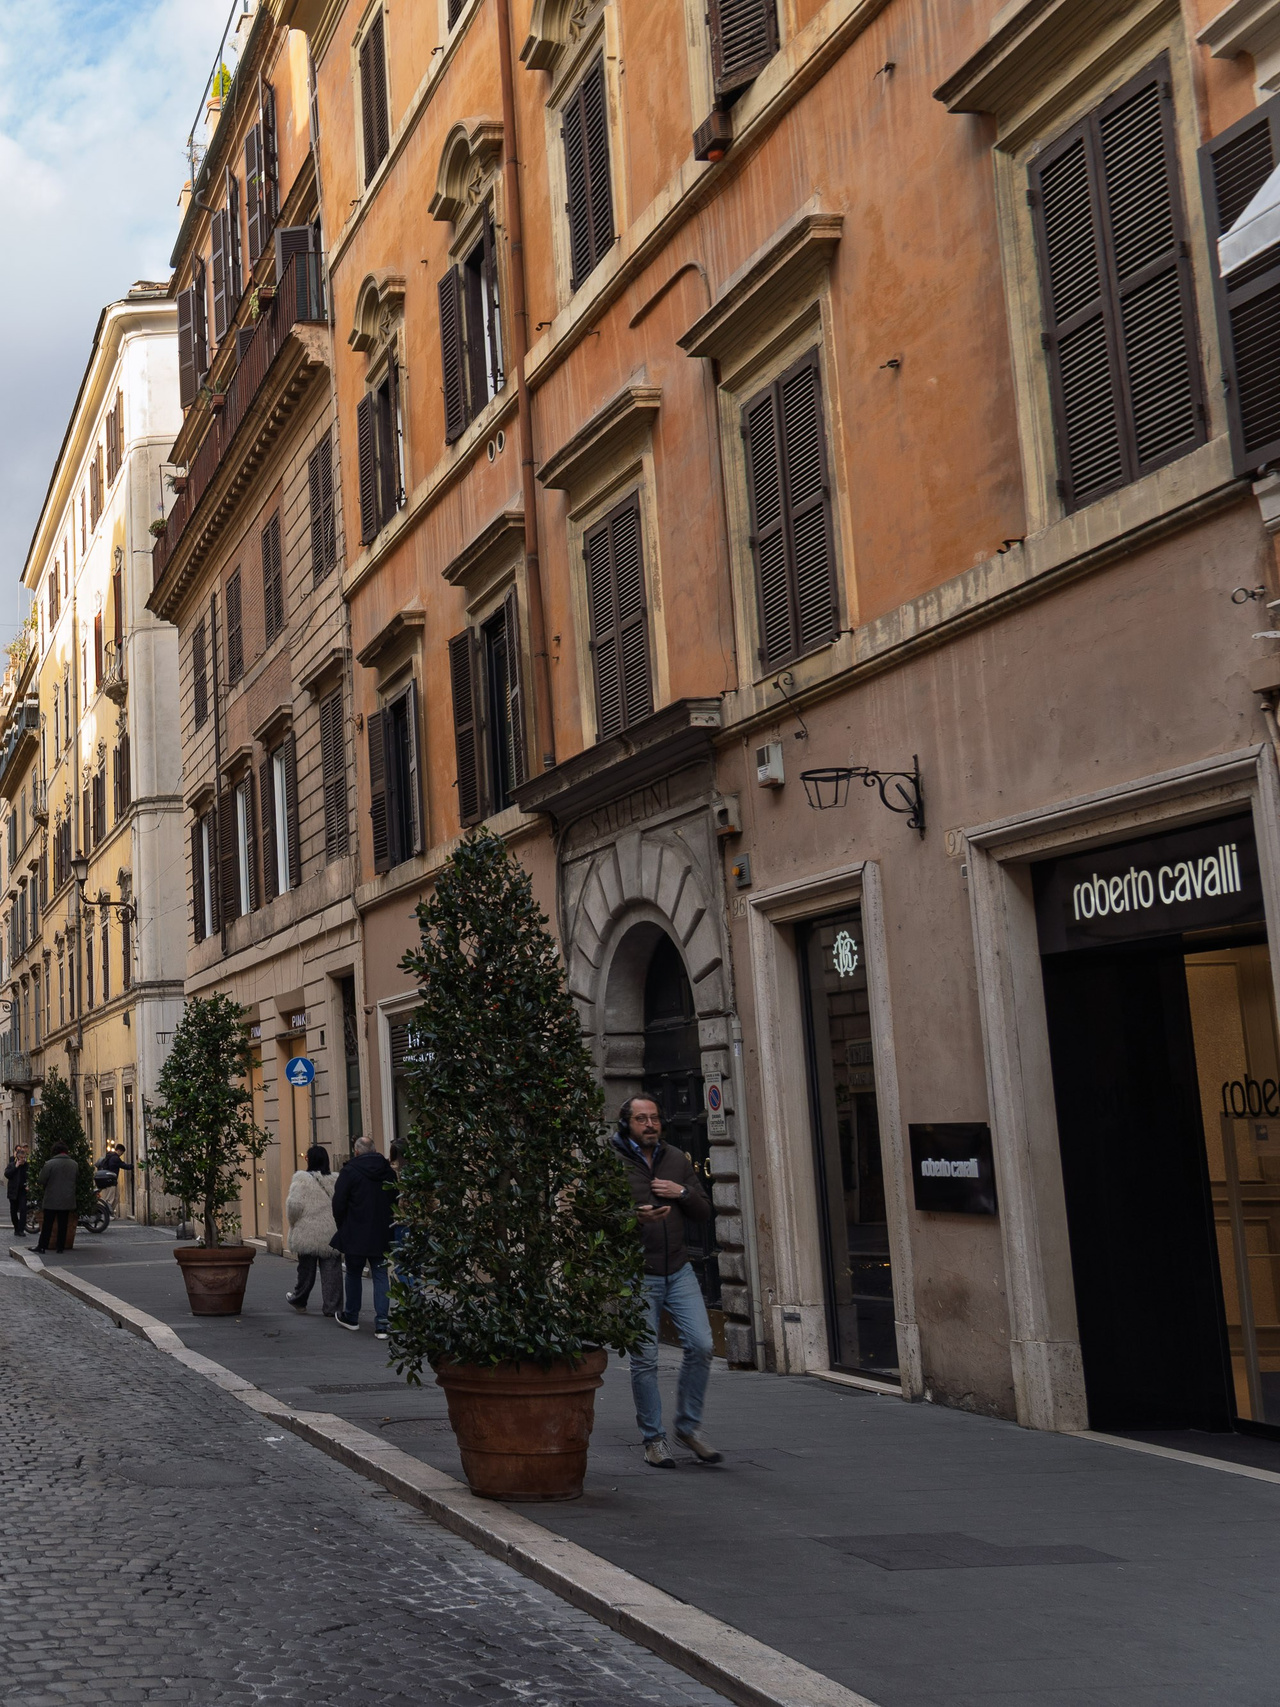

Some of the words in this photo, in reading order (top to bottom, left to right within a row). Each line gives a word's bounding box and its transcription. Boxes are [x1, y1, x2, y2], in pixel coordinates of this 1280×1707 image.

[591, 777, 671, 837] SAULINI
[948, 830, 964, 854] 97
[1073, 866, 1154, 921] roberto
[1158, 843, 1242, 905] cavalli
[732, 896, 747, 917] 96
[1221, 1073, 1280, 1118] robe
